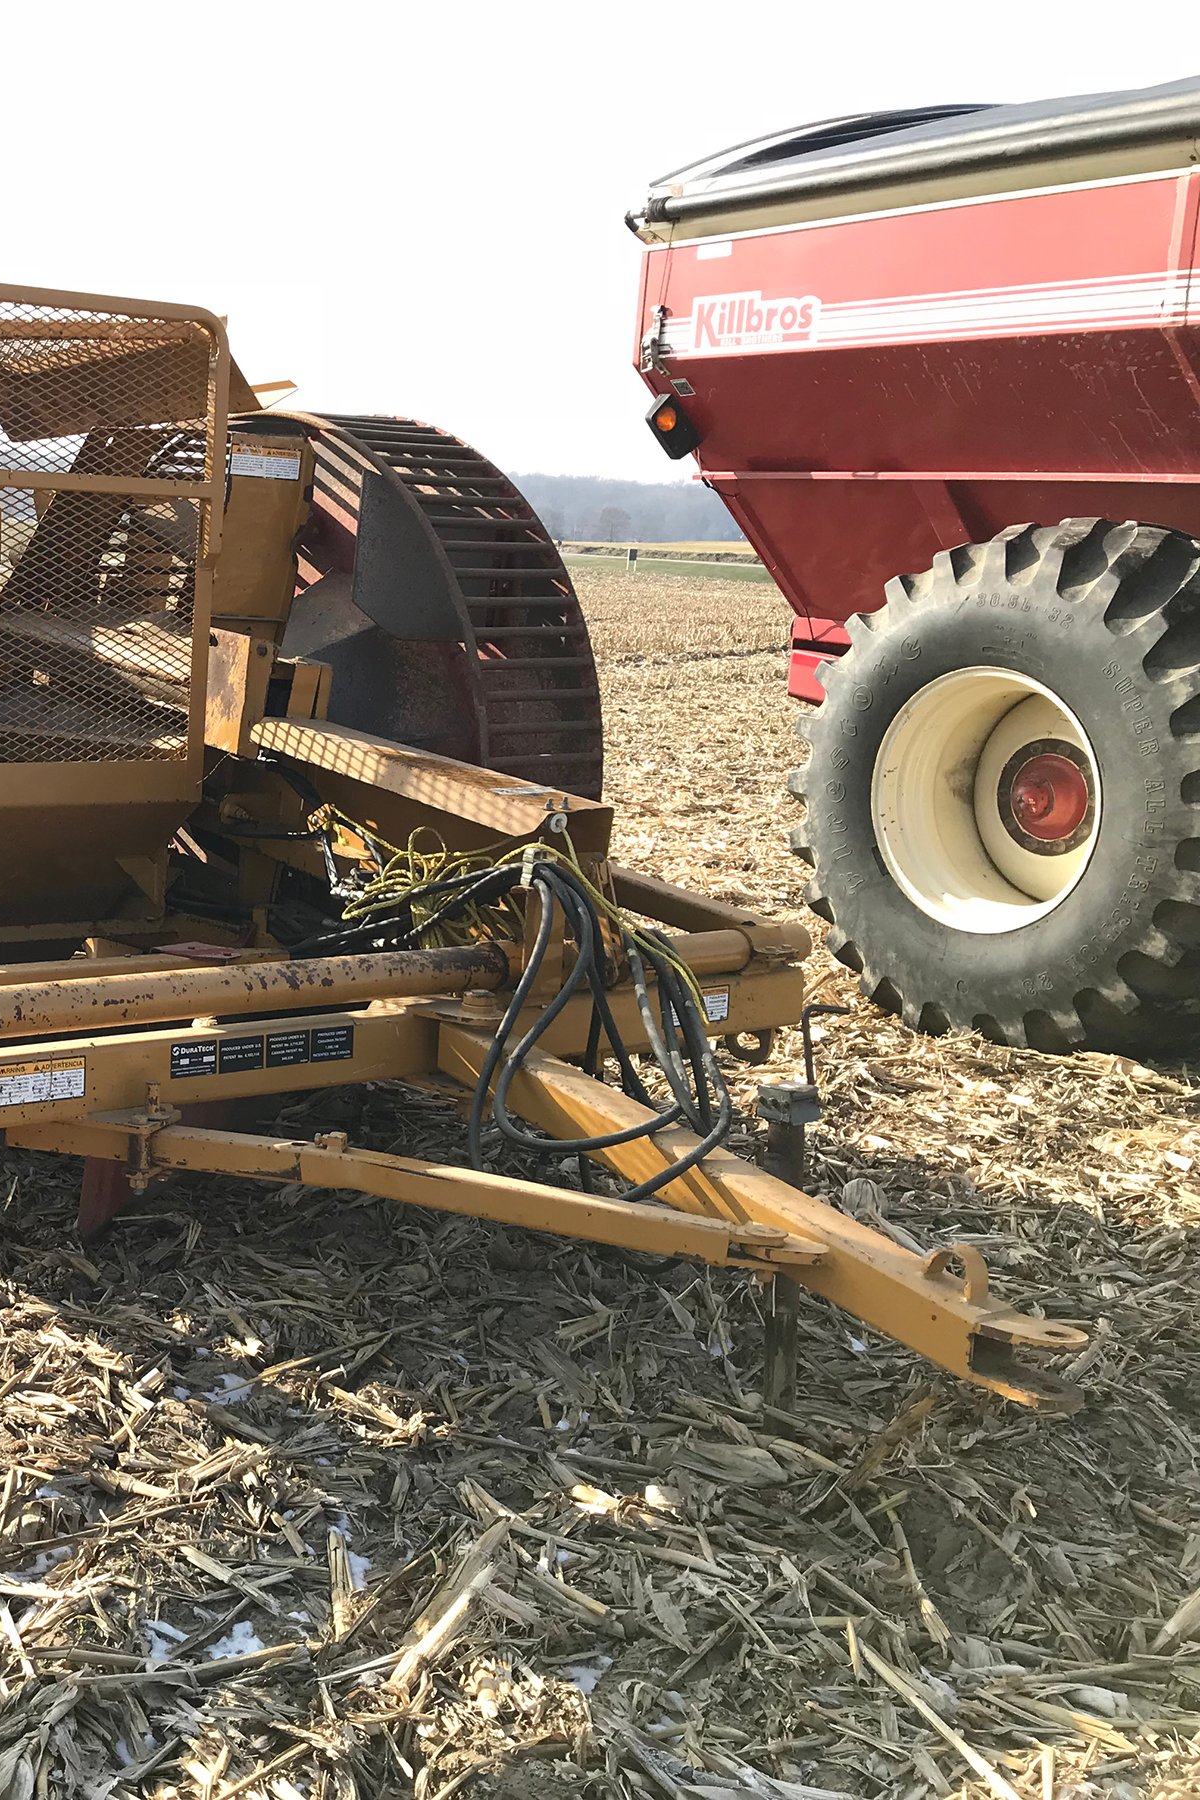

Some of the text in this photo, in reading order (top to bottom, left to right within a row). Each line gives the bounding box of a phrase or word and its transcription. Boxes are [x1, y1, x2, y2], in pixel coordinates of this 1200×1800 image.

[694, 298, 813, 348] Killbros
[1101, 660, 1160, 757] SUPER
[1143, 777, 1167, 834] ALL
